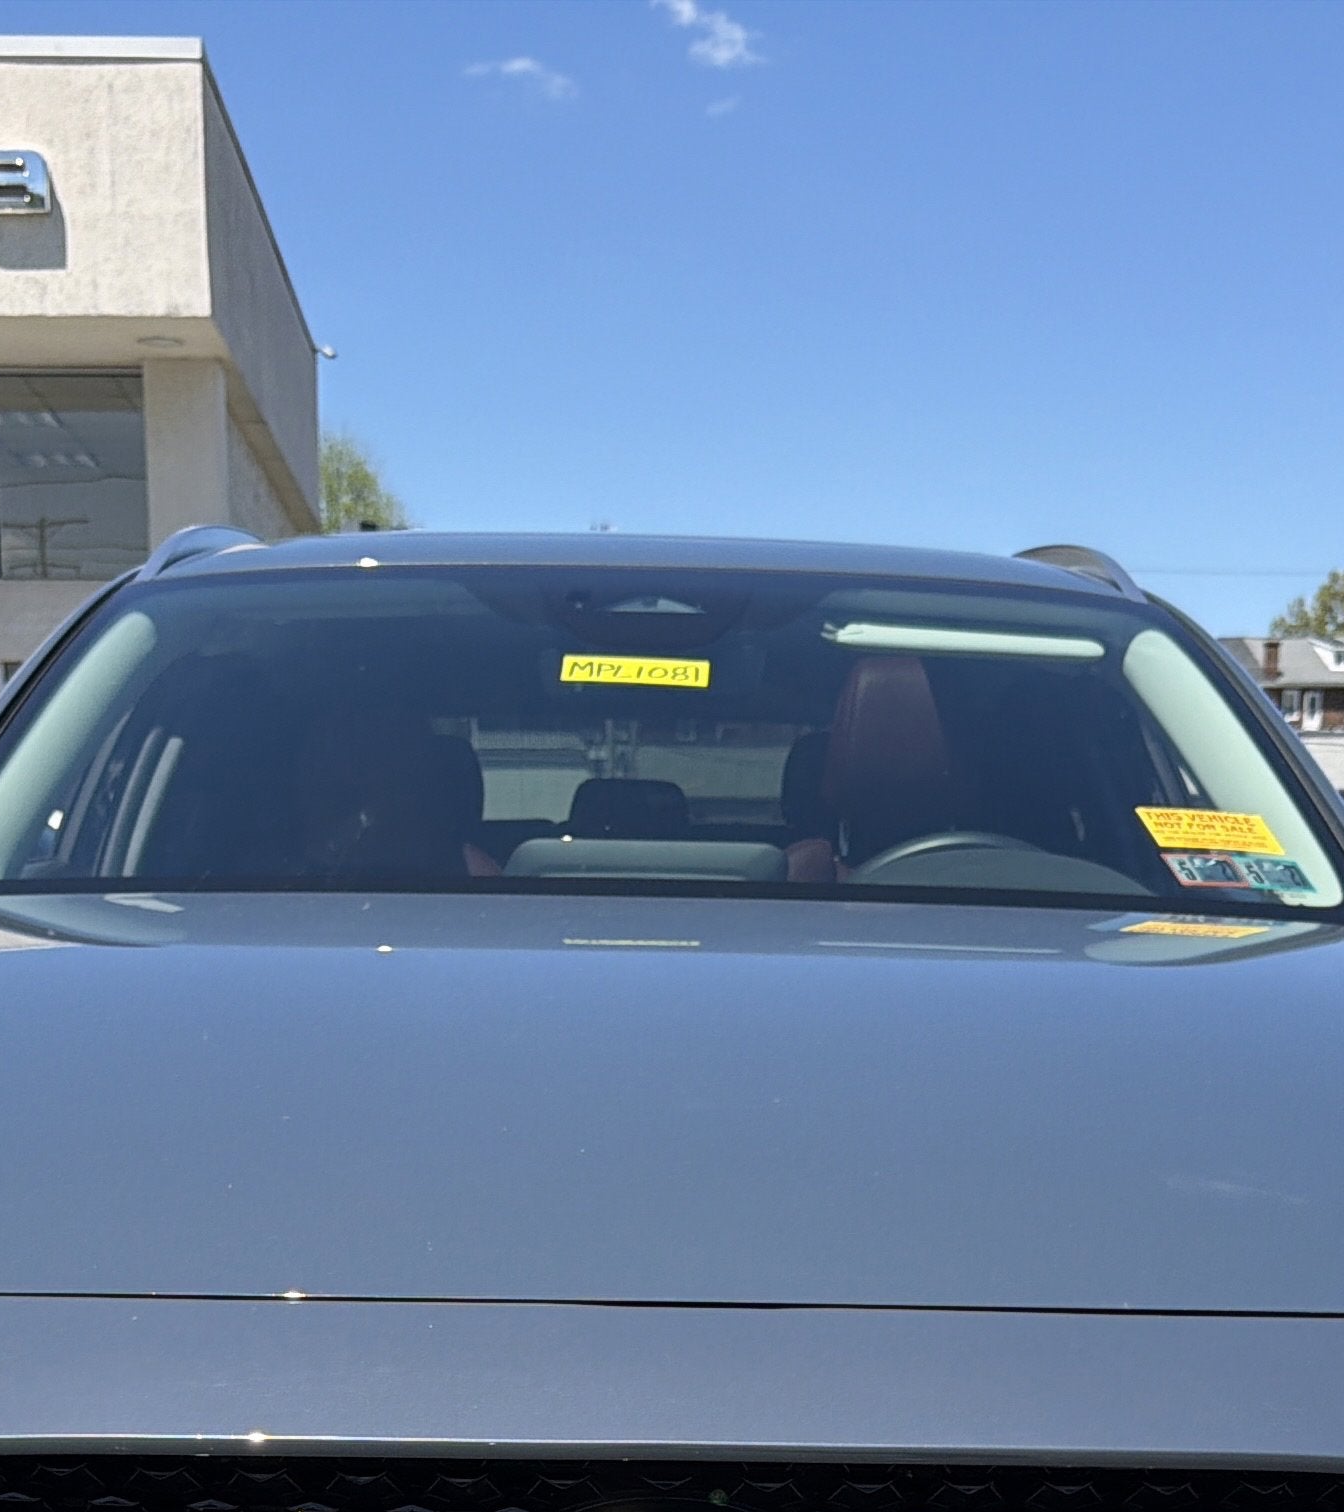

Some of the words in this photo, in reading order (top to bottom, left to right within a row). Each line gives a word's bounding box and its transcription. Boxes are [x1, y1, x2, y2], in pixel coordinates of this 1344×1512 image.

[568, 661, 700, 682] MPL1081
[1145, 812, 1183, 821] THIS
[1185, 814, 1257, 827] VEHICLE
[1186, 823, 1216, 831] FOR
[1221, 825, 1257, 834] SALE
